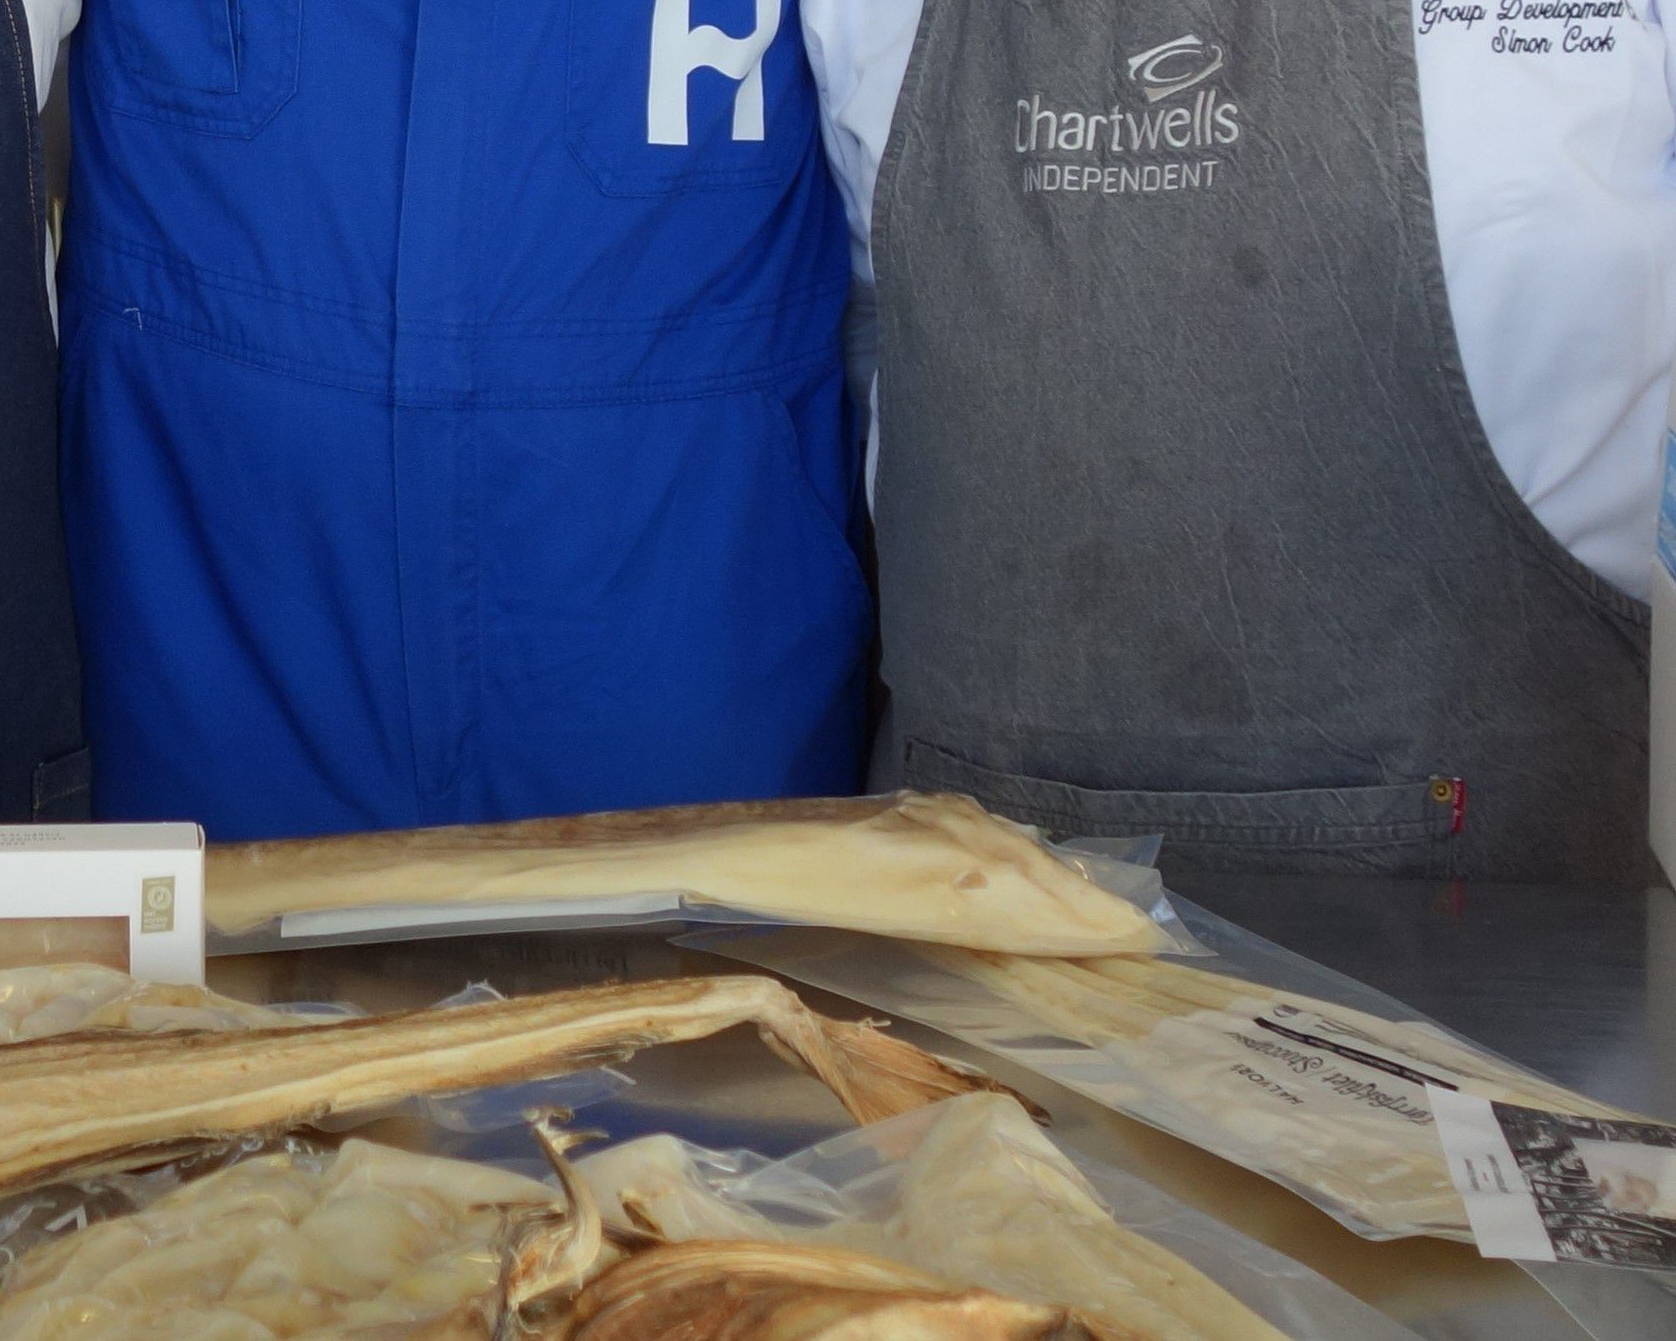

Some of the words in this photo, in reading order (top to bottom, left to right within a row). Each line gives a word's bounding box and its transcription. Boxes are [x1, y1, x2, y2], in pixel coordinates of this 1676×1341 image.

[1491, 26, 1553, 54] Simon
[1562, 25, 1616, 54] Cook
[1015, 89, 1240, 153] Chartwells
[1024, 161, 1218, 194] INDEPENDENT
